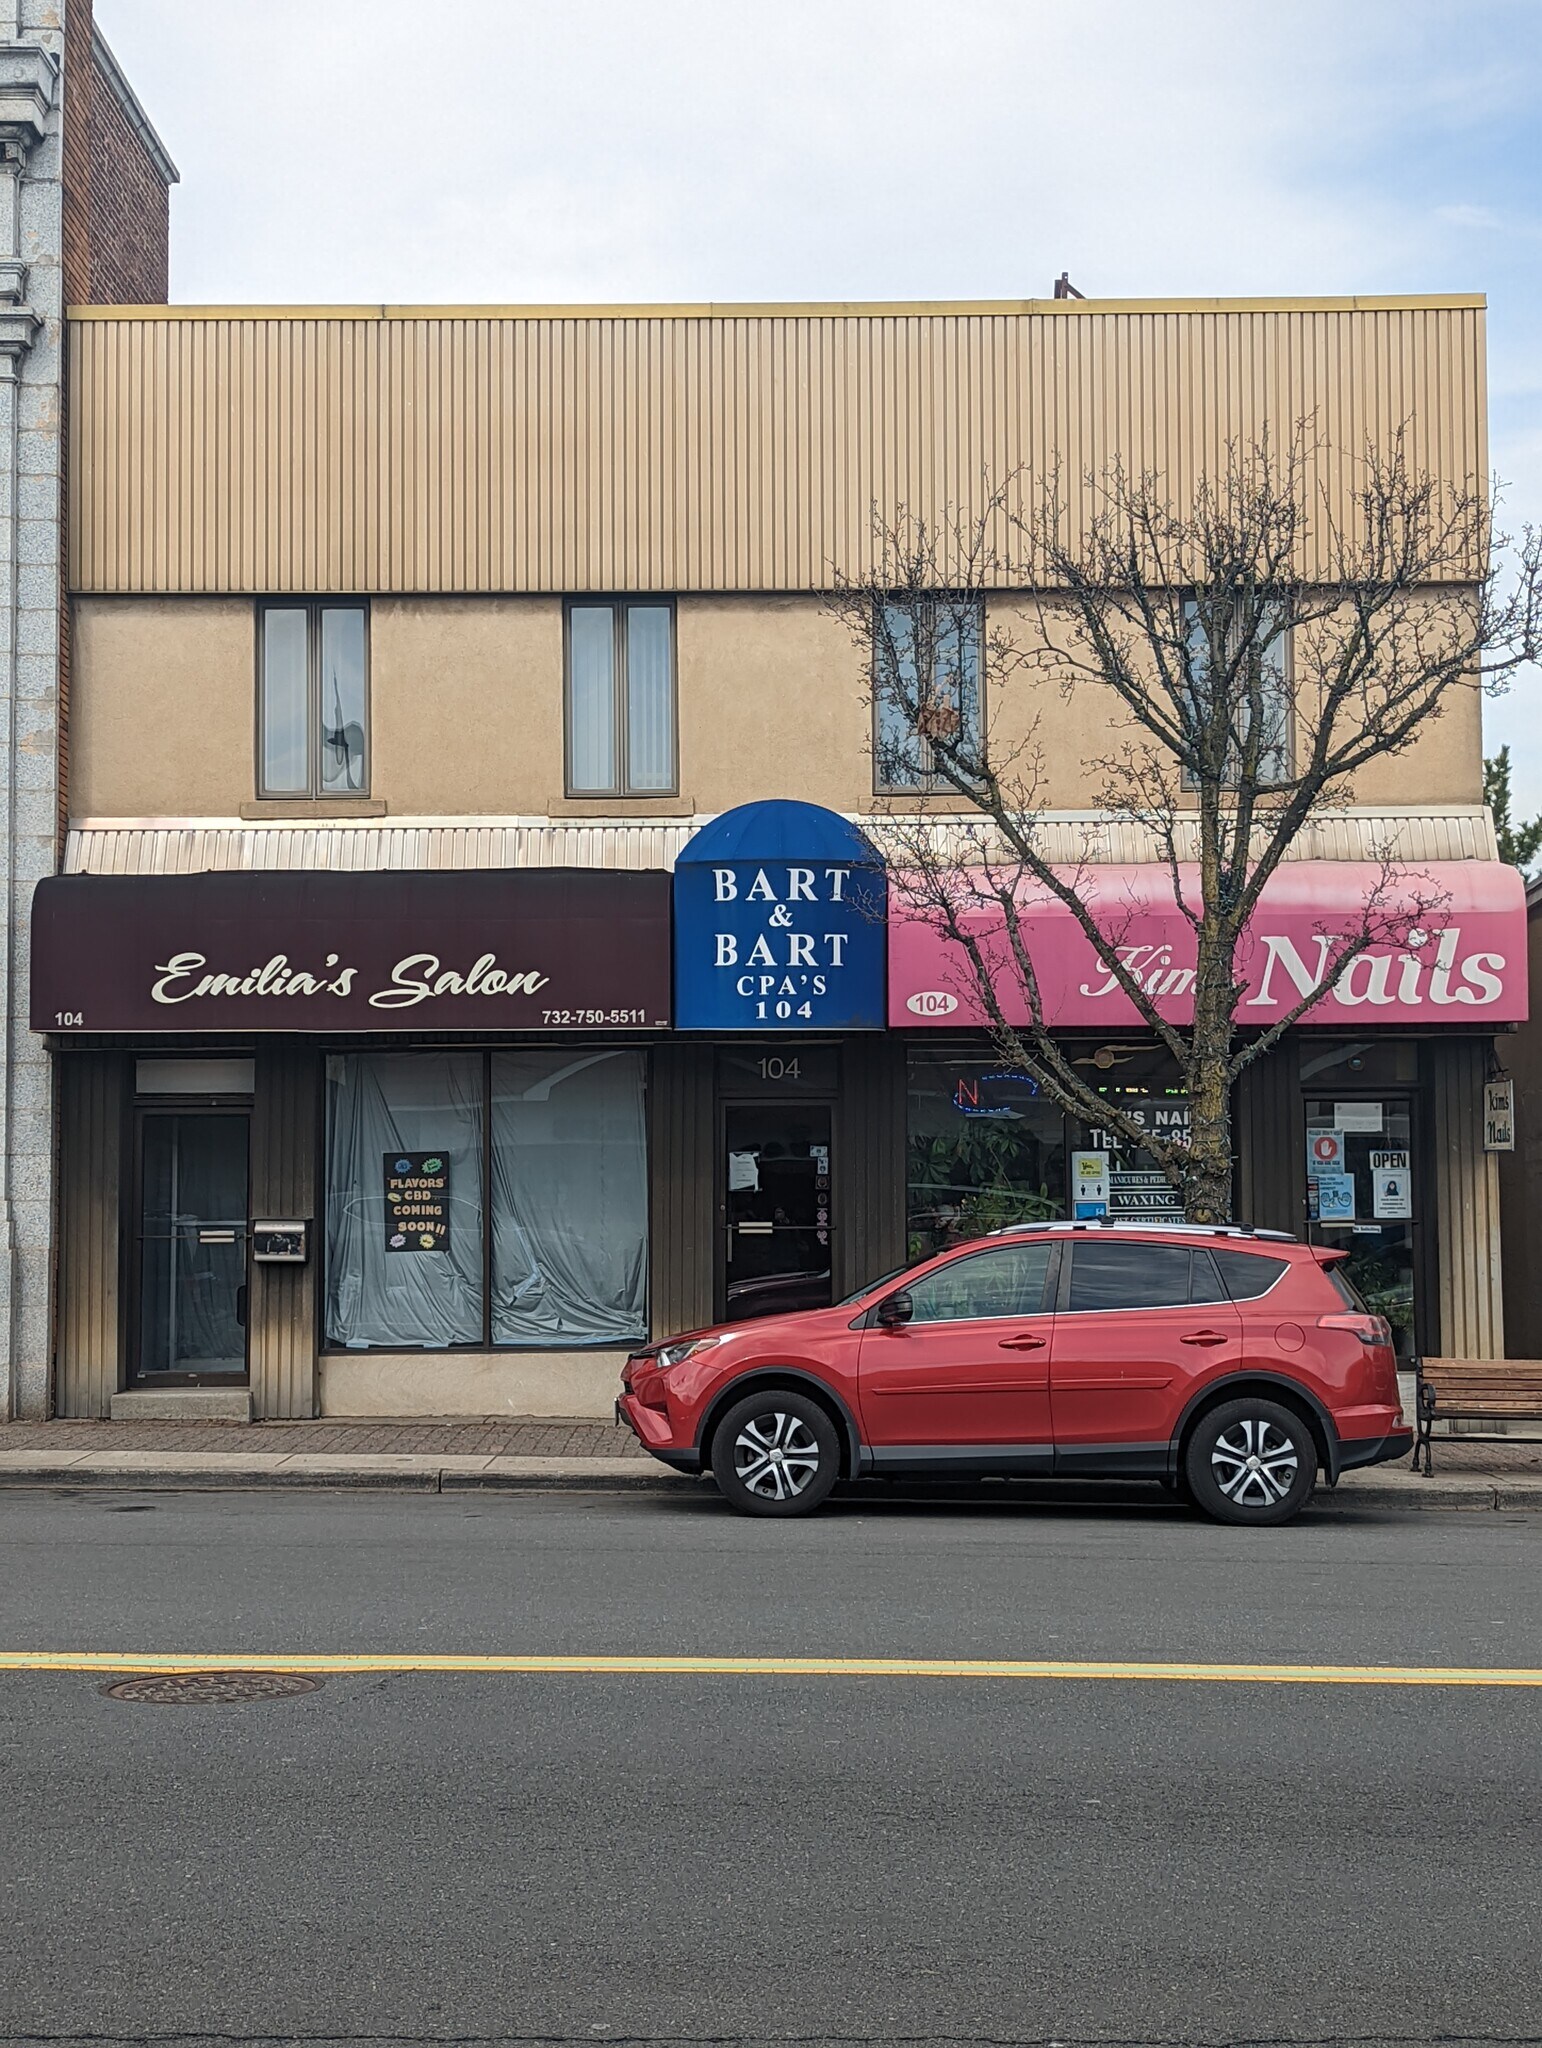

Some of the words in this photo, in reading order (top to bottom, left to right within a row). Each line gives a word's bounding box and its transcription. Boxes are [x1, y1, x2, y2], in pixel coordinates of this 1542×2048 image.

[711, 868, 851, 902] BART
[768, 904, 794, 927] &
[713, 933, 849, 967] BART
[1246, 928, 1507, 1006] Nails
[150, 951, 359, 1005] Emilia's
[368, 953, 550, 1009] Salon
[736, 975, 827, 996] CPA'S
[755, 1001, 813, 1019] 104
[916, 995, 950, 1012] 104
[54, 1013, 84, 1026] 104
[541, 1008, 646, 1024] 732-750-5511
[757, 1058, 802, 1079] 104
[1373, 1152, 1407, 1168] OPEN
[393, 1204, 442, 1216] COMING
[1118, 1195, 1176, 1206] WAXING
